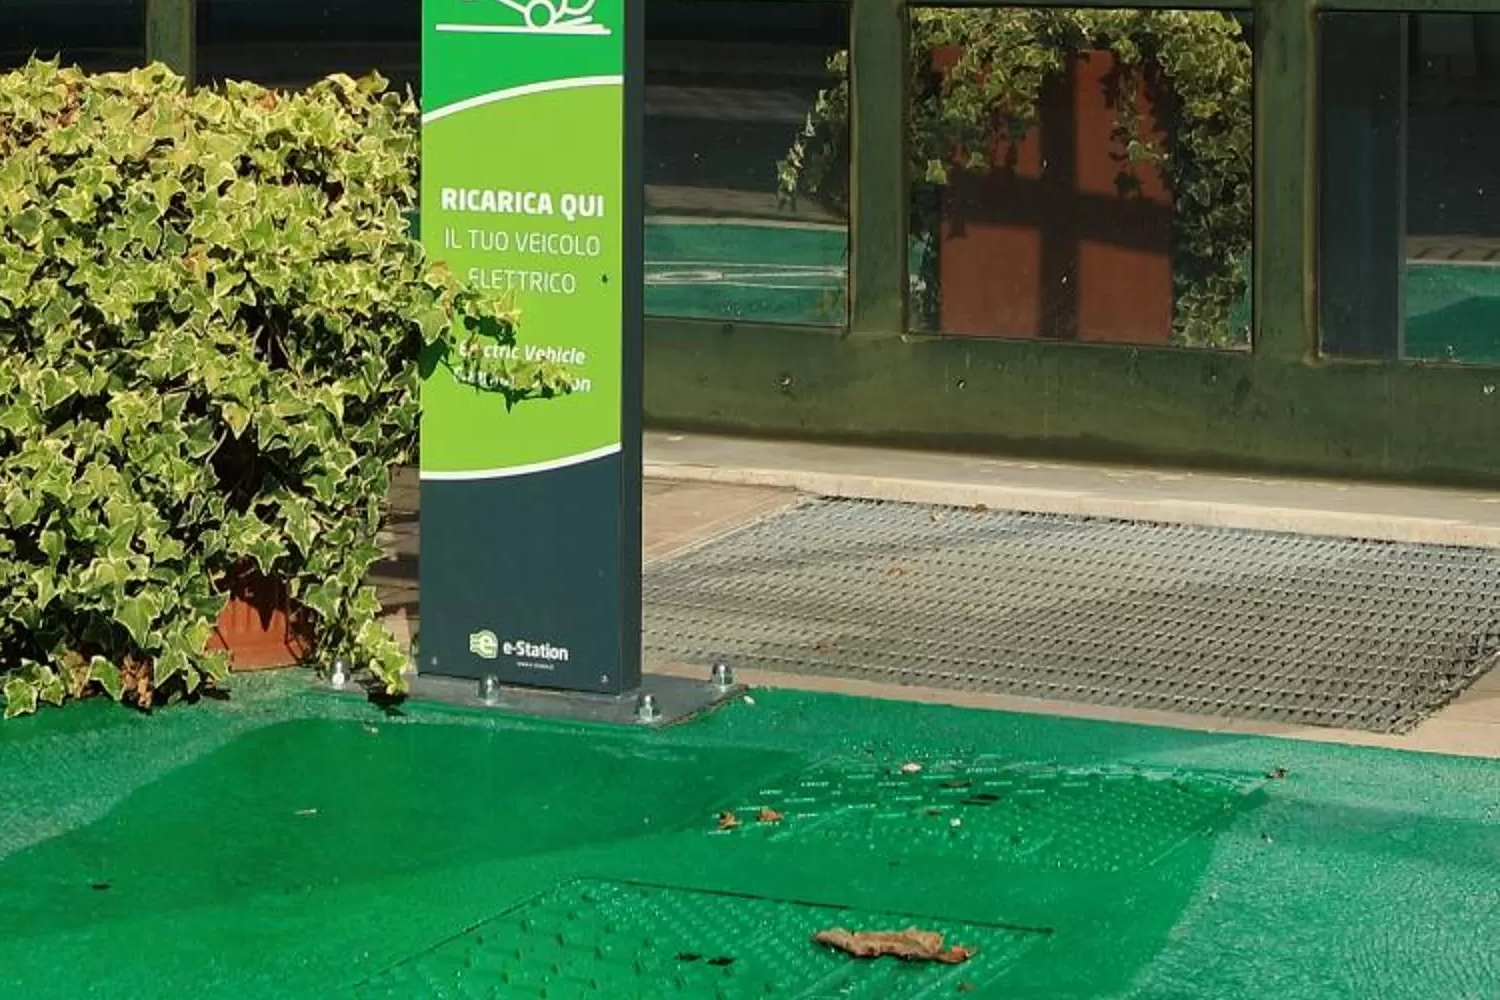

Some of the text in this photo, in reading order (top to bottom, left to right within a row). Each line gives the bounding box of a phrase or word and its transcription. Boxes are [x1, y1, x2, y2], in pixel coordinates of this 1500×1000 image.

[441, 188, 605, 221] RICARICA QUI
[444, 229, 600, 257] IL TUO VEICOLO
[468, 267, 576, 294] ELETTRICO
[460, 340, 585, 364] Ectric Vehicle
[503, 640, 569, 661] e-Station
